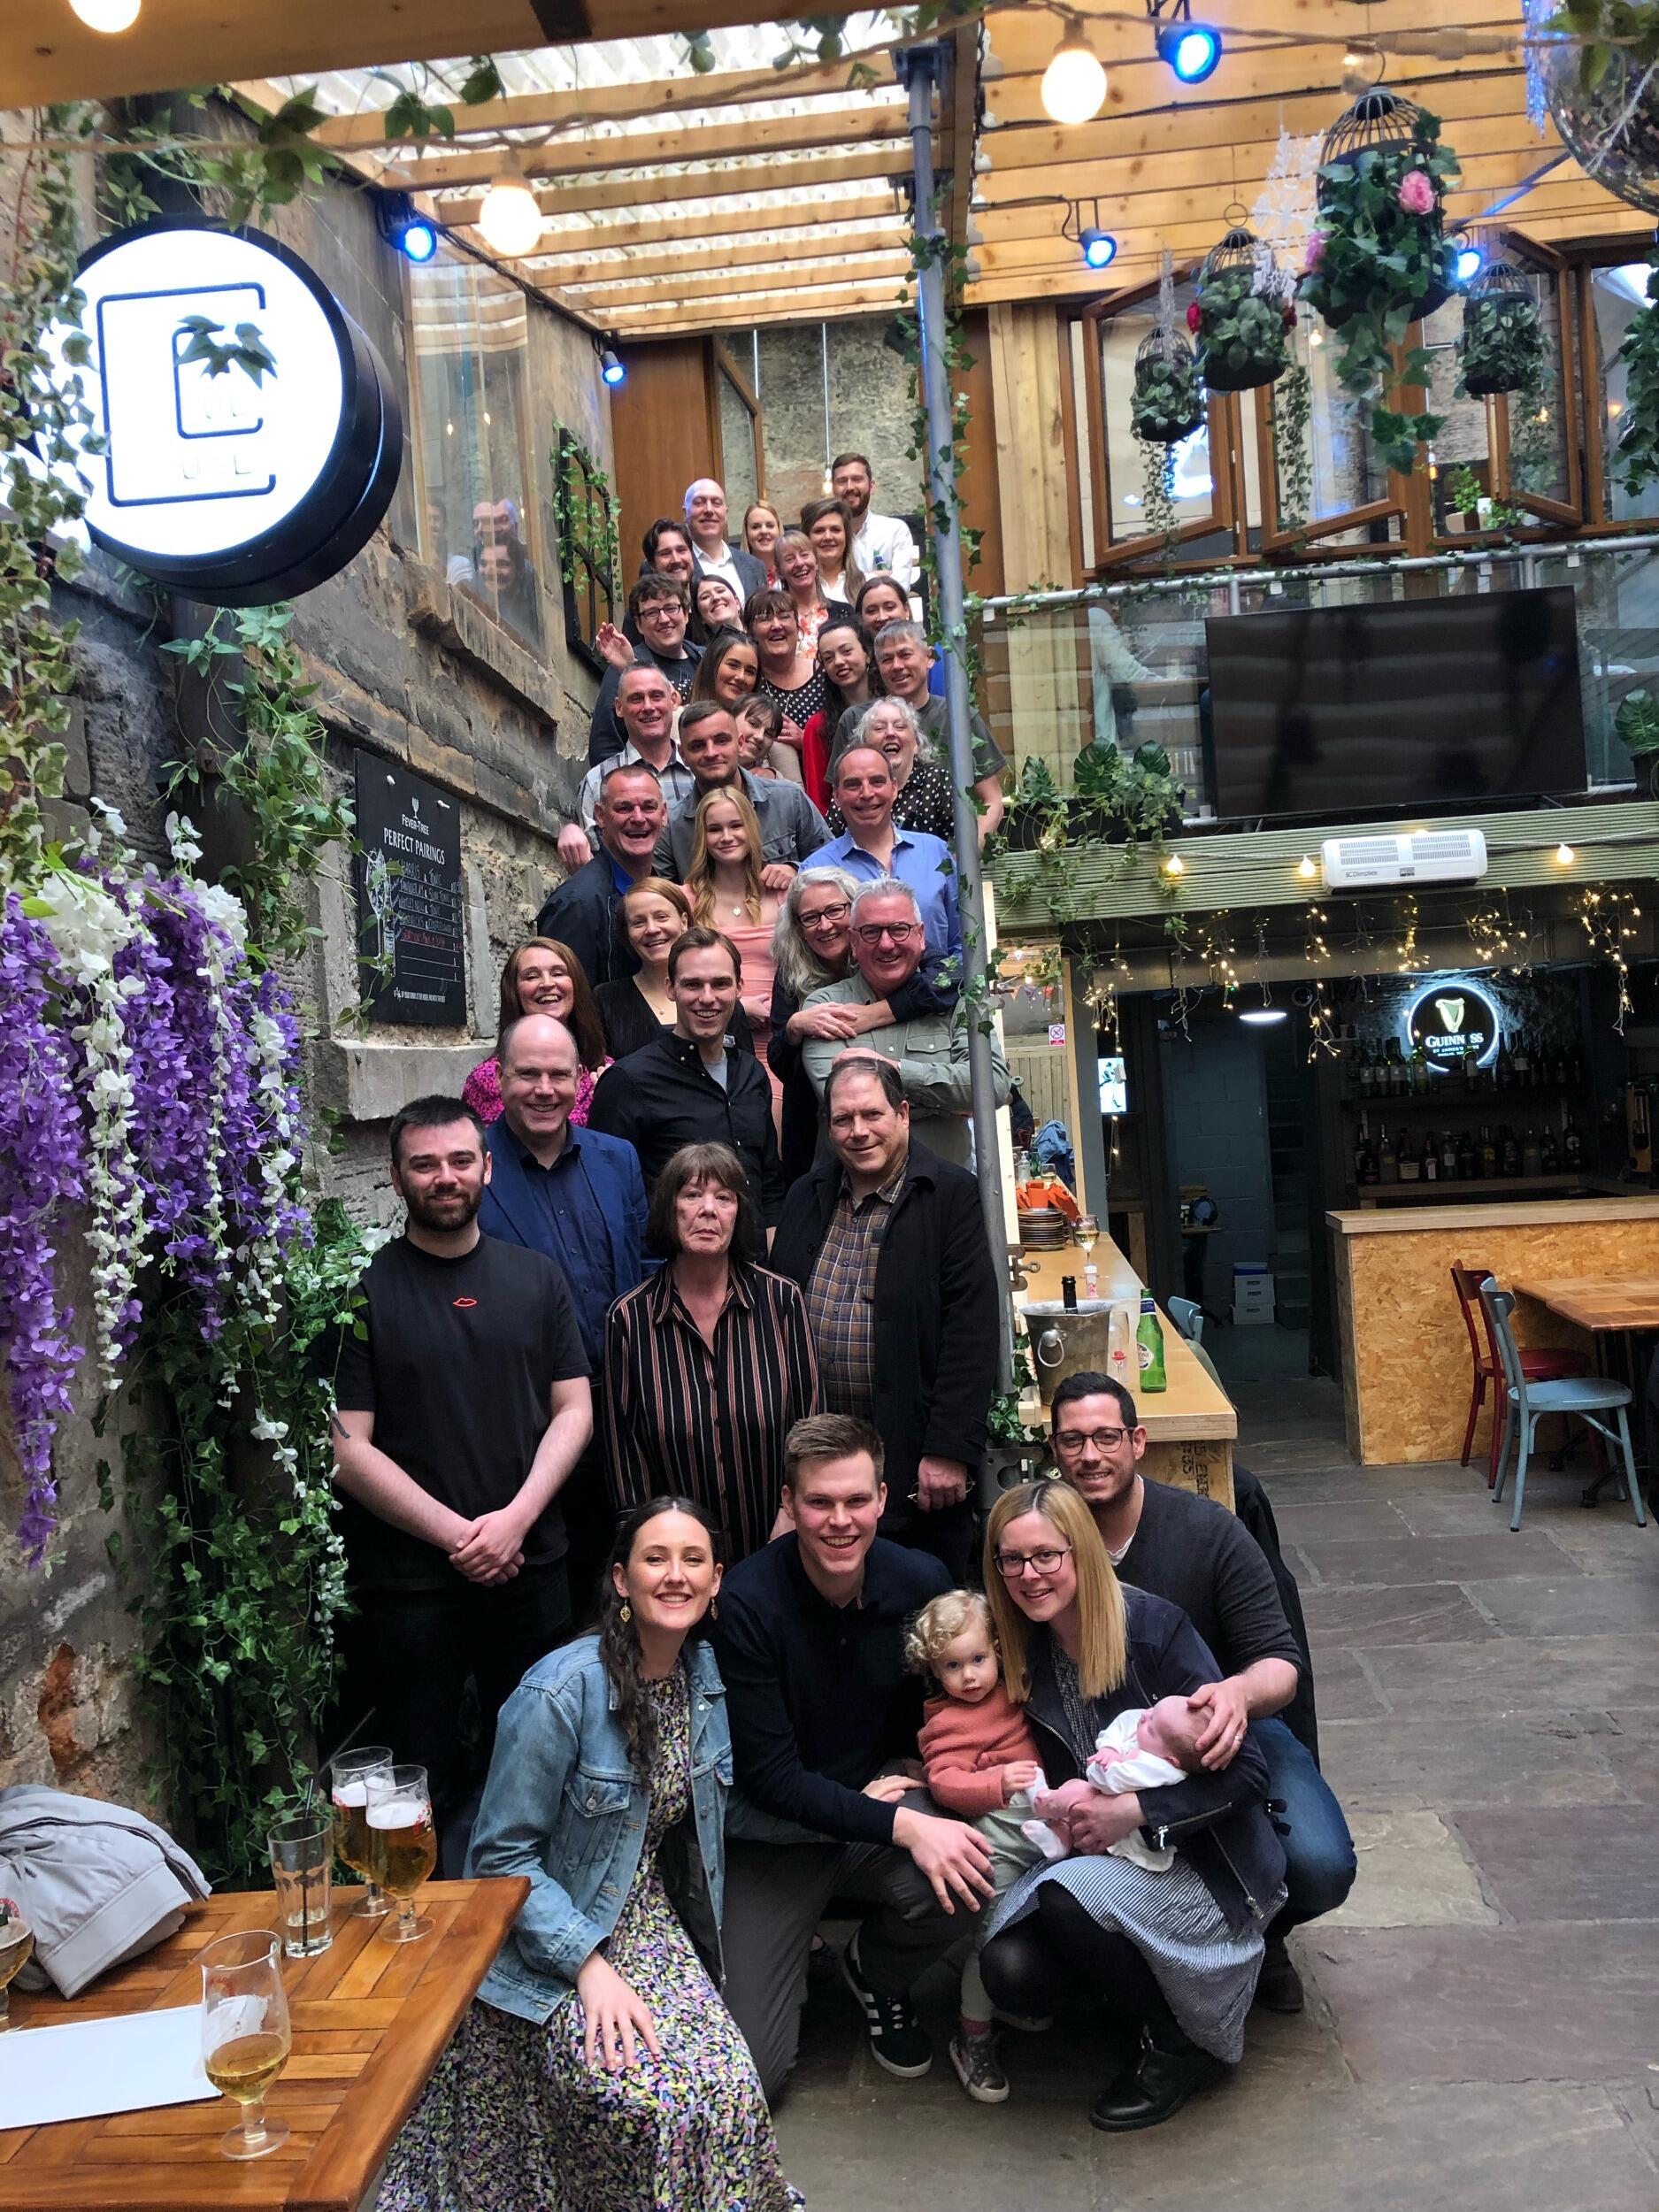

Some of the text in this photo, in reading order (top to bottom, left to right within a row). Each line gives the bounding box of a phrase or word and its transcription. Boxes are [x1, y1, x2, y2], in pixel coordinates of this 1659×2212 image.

[402, 814, 430, 835] FEVER-TREE
[384, 827, 445, 865] PERFECT PAIRINGS
[1425, 1033, 1484, 1048] GUINNSS
